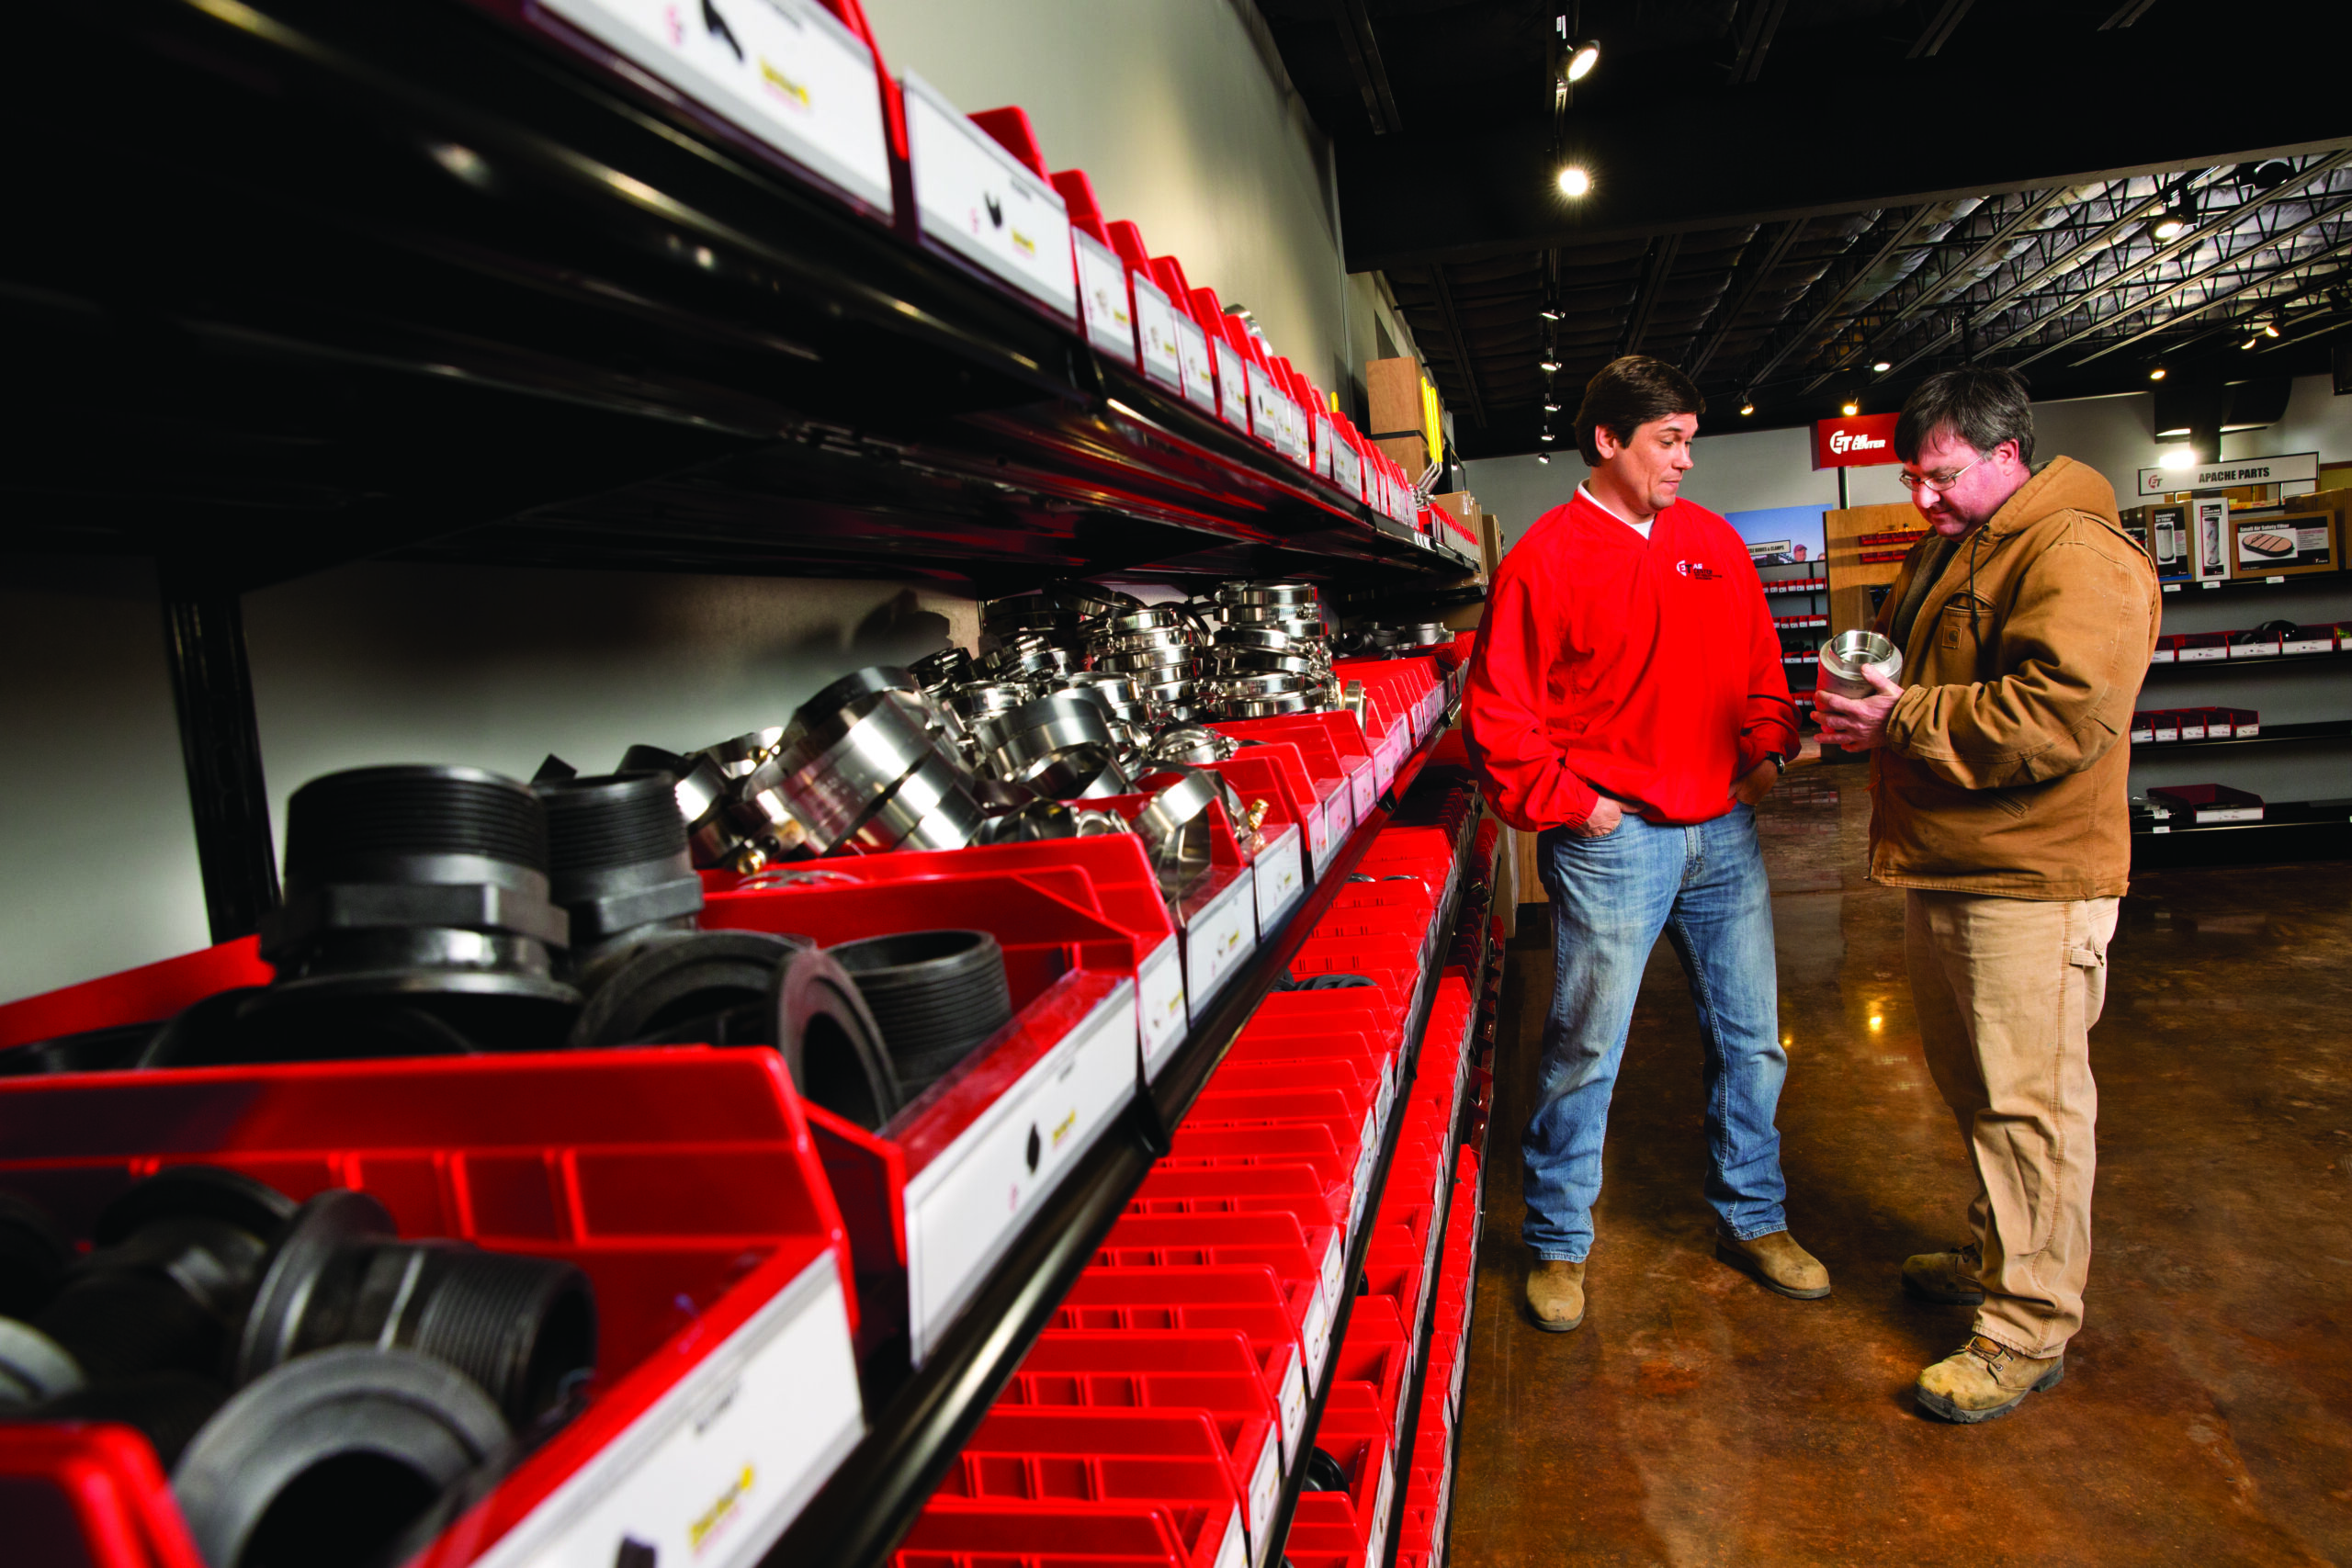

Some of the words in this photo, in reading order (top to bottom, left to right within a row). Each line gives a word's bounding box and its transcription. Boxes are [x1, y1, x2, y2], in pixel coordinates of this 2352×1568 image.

[1851, 440, 1885, 450] CENTER
[2199, 469, 2236, 483] APACHE
[2238, 467, 2270, 479] PARTS
